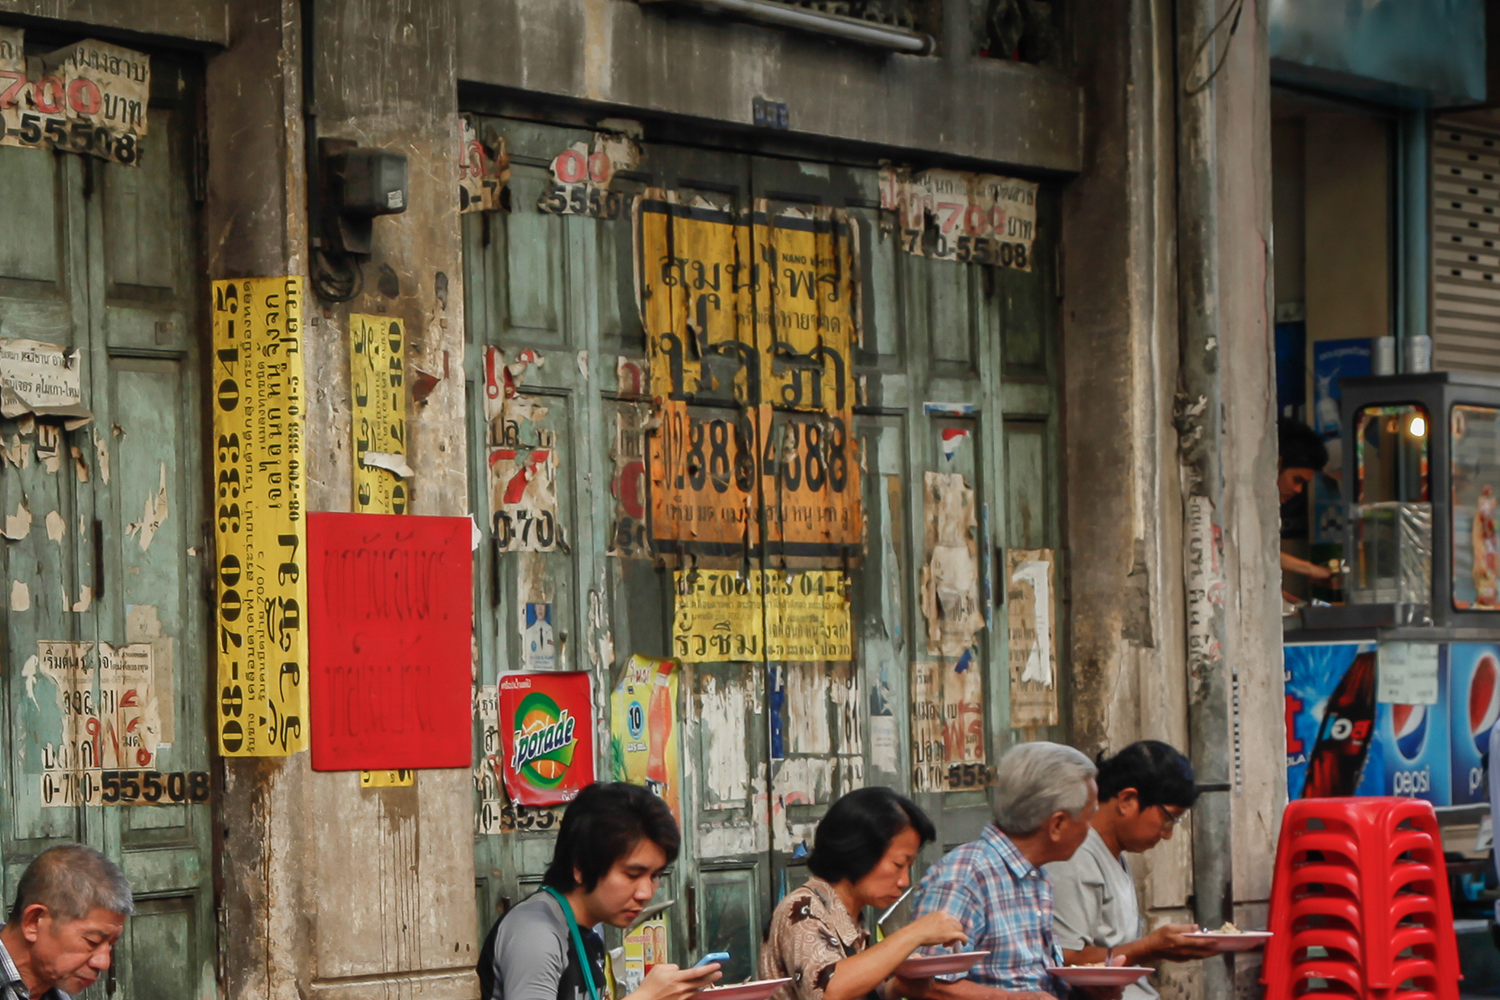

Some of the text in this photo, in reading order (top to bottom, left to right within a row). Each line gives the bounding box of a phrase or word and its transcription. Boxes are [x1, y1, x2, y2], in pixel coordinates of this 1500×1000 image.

[104, 92, 142, 128] บาท
[781, 253, 807, 264] NANO
[257, 294, 281, 358] จิ้งจก
[266, 363, 288, 399] หนู
[279, 280, 300, 522] 08-700 333 04-5 ปลวก
[216, 282, 243, 753] 08-700 333 04-5
[259, 534, 301, 752] รั่วซึม
[629, 705, 641, 730] 10
[1392, 765, 1431, 797] pepsi
